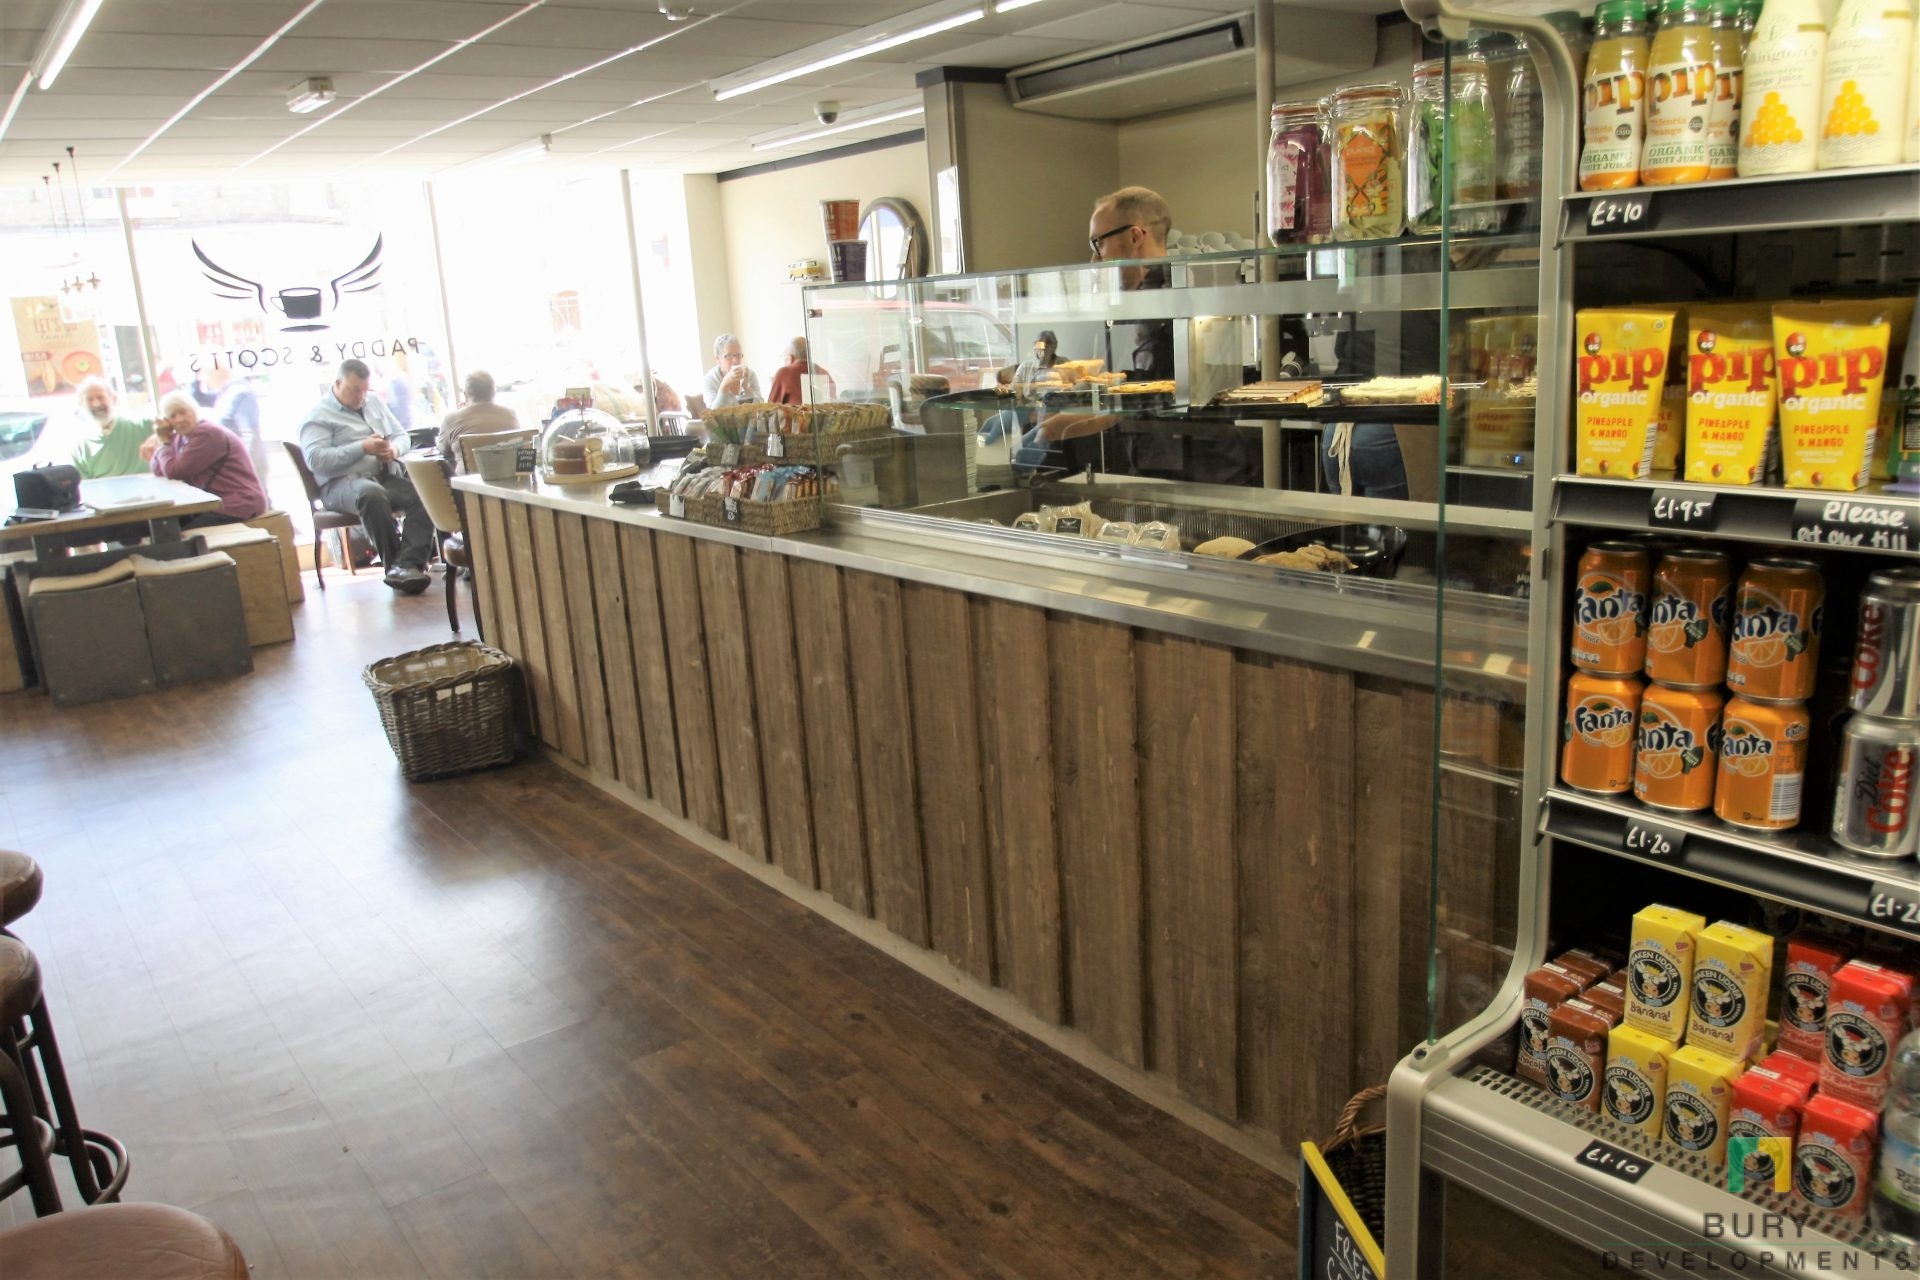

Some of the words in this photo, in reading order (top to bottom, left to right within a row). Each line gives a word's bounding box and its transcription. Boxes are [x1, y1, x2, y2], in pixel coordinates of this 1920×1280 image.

[1647, 63, 1717, 117] pip
[1591, 201, 1643, 226] £2.10
[1578, 347, 1665, 398] pip
[1689, 347, 1775, 398] pip
[1777, 346, 1884, 404] pip
[1581, 390, 1649, 408] organic
[1691, 390, 1767, 409] organic
[1785, 393, 1867, 415] organic
[1587, 417, 1633, 427] PINEAPPLE
[1598, 429, 1628, 439] MANGO
[1699, 418, 1750, 430] PINEAPPLE
[1794, 424, 1849, 435] PINEAPPLE
[1711, 431, 1744, 442] MANGO
[1808, 436, 1844, 448] MANGO
[1654, 497, 1711, 522] £1.95
[1823, 501, 1906, 527] Please
[1870, 530, 1907, 551] till
[1652, 592, 1698, 625] nta
[1733, 605, 1799, 642] anta
[1575, 706, 1633, 734] Fanta
[1637, 721, 1693, 753] anta
[1723, 733, 1772, 757] anta
[1866, 751, 1915, 834] Coke
[1627, 826, 1670, 855] £1.20
[1631, 950, 1654, 967] HAKEN
[1655, 954, 1678, 979] UDDER
[1694, 968, 1717, 984] AKEN
[1718, 973, 1742, 1000] UDDER
[1522, 1009, 1541, 1021] AKEN
[1630, 1001, 1671, 1023] Banana!
[1691, 1019, 1735, 1043] Banana!
[1547, 1047, 1566, 1058] AKEN
[1567, 1053, 1590, 1077] UDDER
[1606, 1067, 1628, 1081] AKEN
[1629, 1073, 1652, 1098] UDDER
[1667, 1091, 1690, 1106] AKEN
[1586, 1148, 1640, 1174] £1.10
